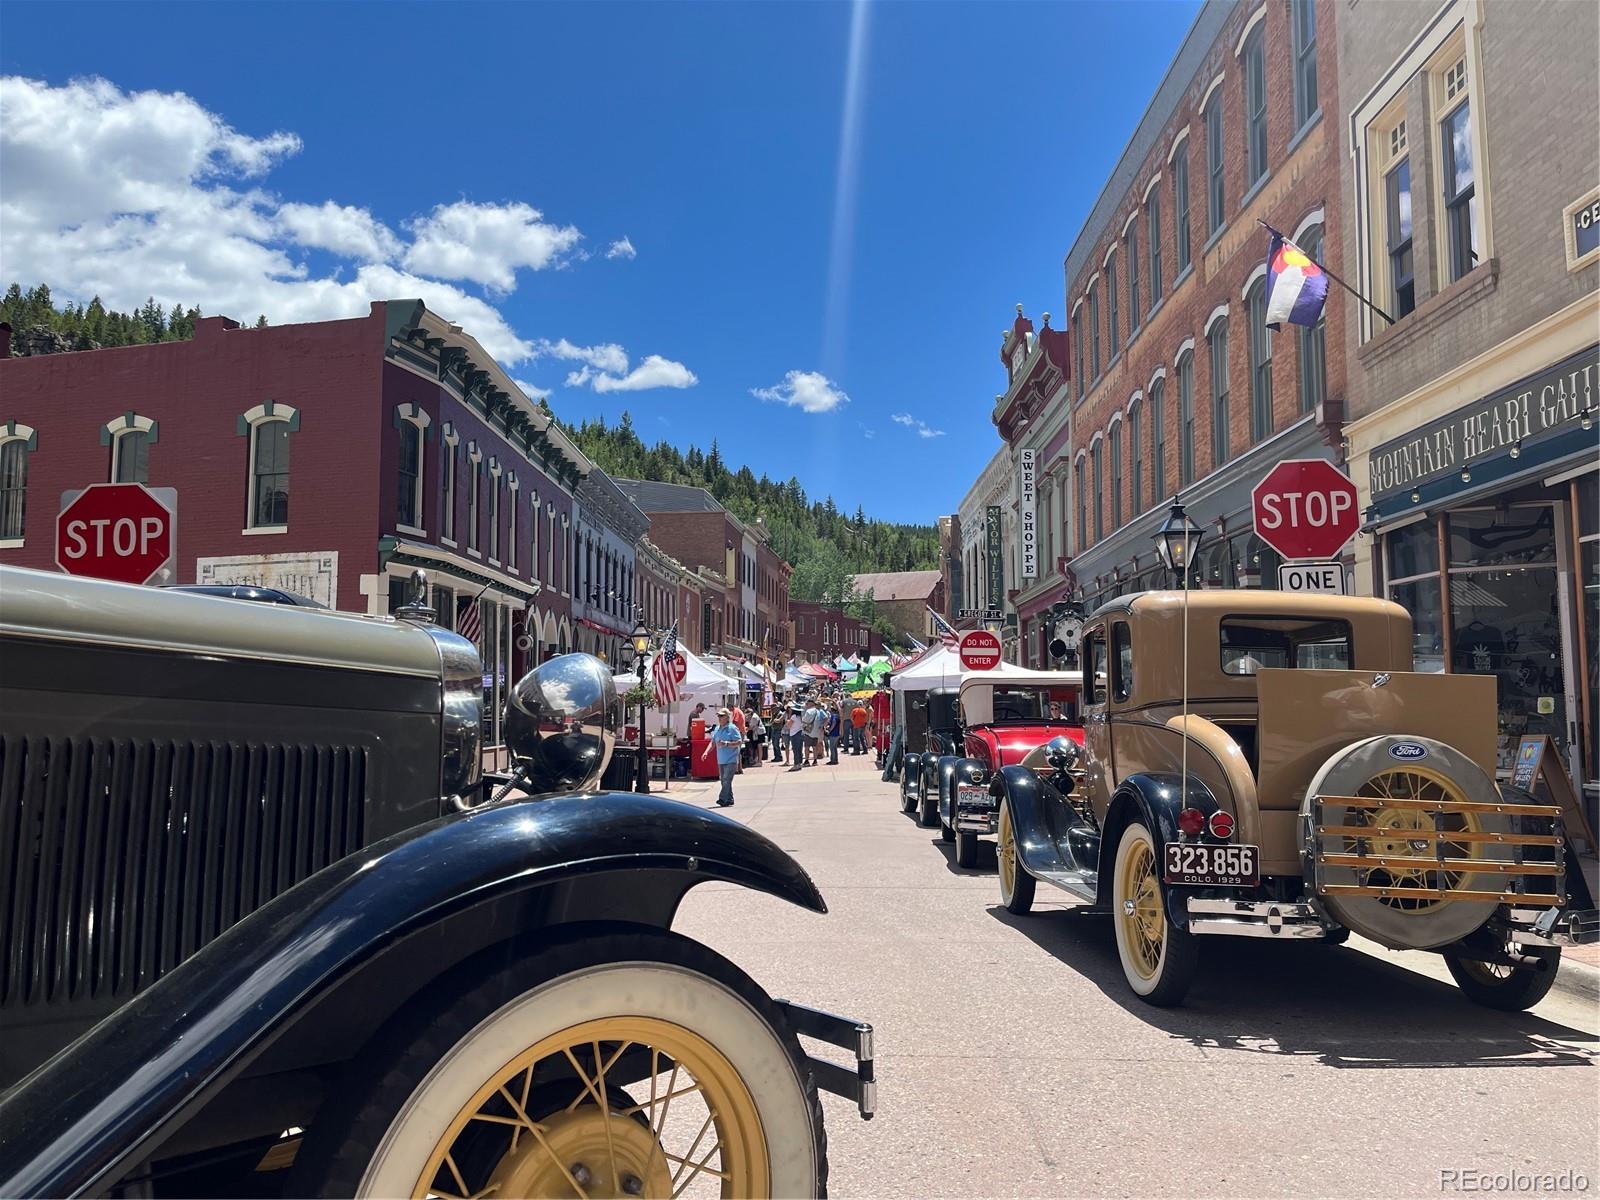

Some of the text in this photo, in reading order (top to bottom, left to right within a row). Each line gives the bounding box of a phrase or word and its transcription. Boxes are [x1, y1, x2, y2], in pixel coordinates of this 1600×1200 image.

[1369, 363, 1600, 494] MOUNTAIN HEART GALL
[1022, 451, 1034, 574] SWEET SHOPPE
[1261, 490, 1352, 529] STOP
[64, 517, 164, 559] STOP
[1288, 570, 1336, 591] ONE
[979, 639, 993, 647] NOT
[969, 657, 992, 665] ENTER
[1396, 745, 1420, 756] Ford
[1184, 875, 1214, 883] COLO.
